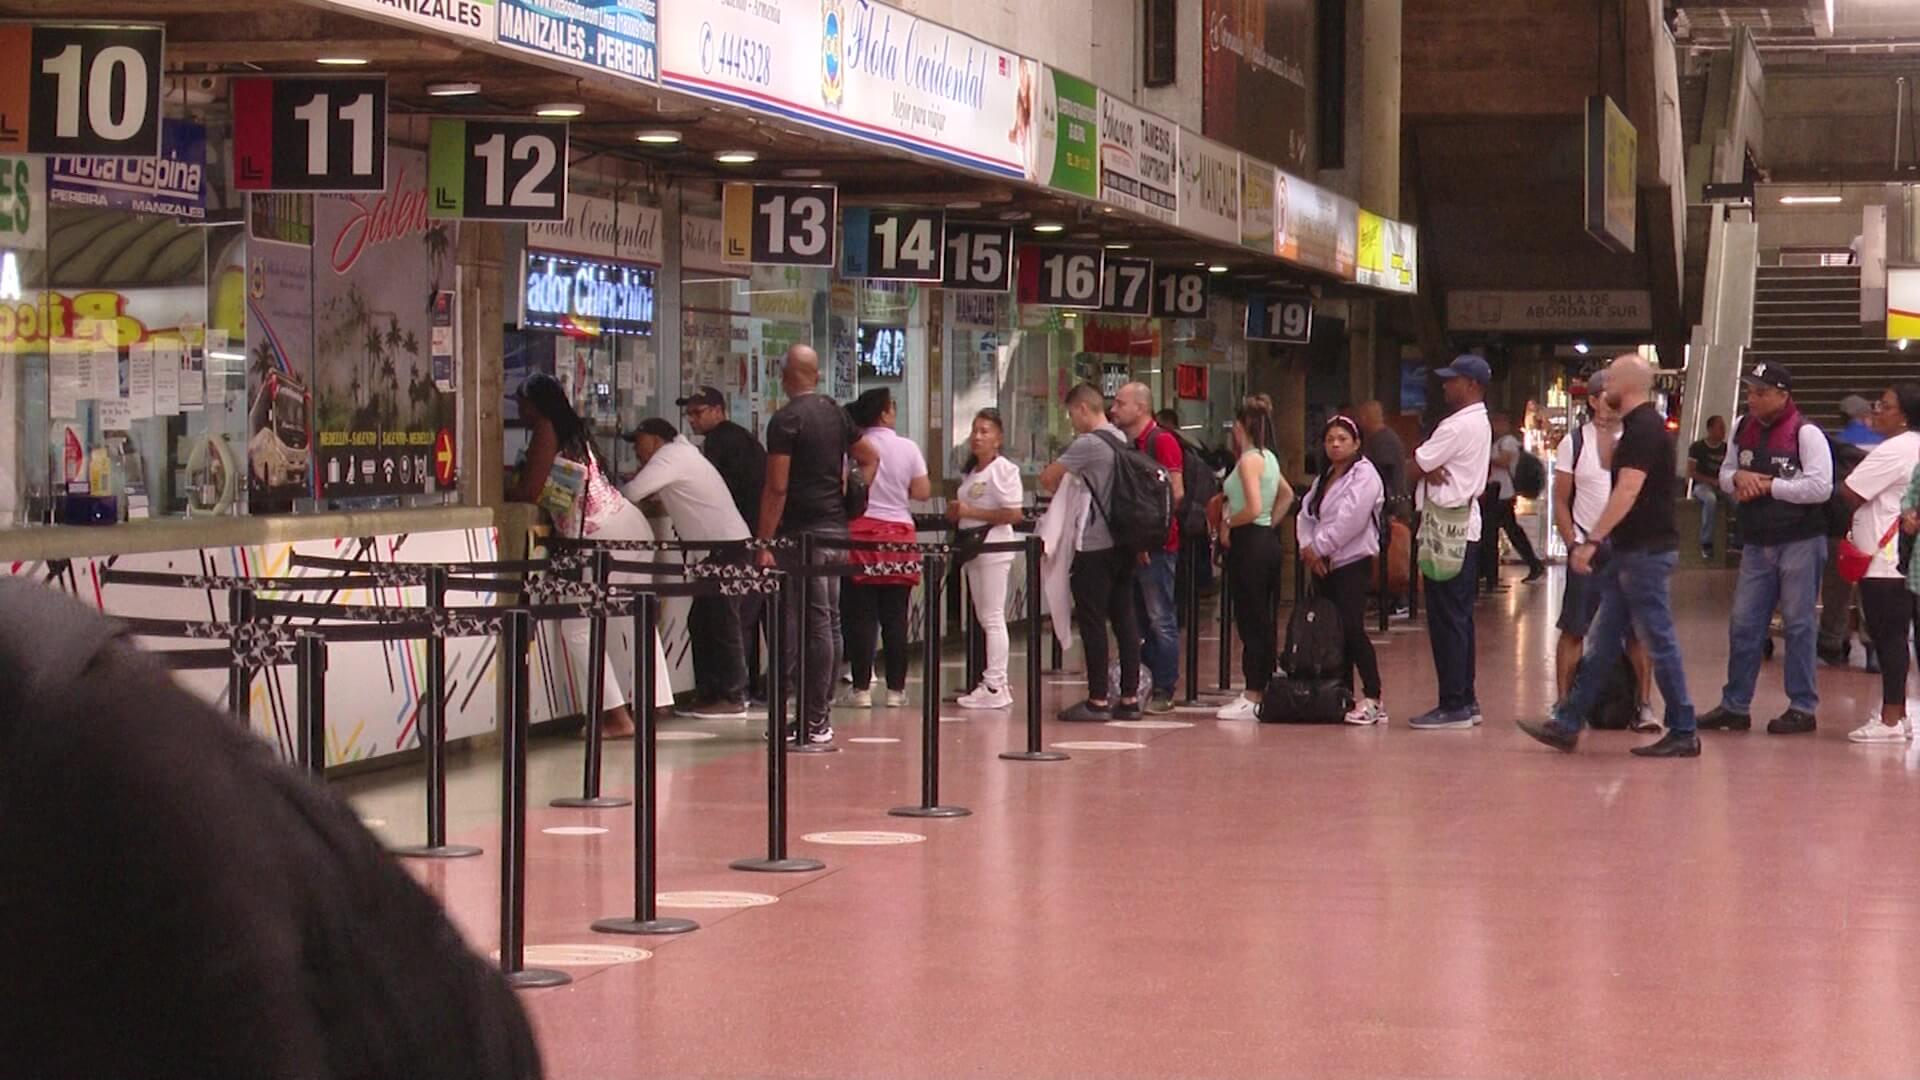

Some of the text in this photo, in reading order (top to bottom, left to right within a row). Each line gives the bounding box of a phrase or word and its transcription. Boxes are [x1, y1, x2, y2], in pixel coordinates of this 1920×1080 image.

[597, 32, 656, 80] PEREIRA
[718, 32, 772, 86] 4445328
[904, 17, 988, 110] Occidental
[42, 44, 149, 141] 10
[295, 93, 374, 176] 11
[122, 150, 200, 194] Ospina
[474, 133, 557, 208] 12
[51, 188, 108, 206] PEREIRA
[132, 199, 205, 218] MANIZALES
[580, 200, 657, 249] Occidental
[759, 195, 827, 256] 13
[874, 217, 936, 271] 14
[948, 232, 1002, 283] 15
[1044, 254, 1096, 300] 16
[1104, 266, 1146, 308] 17
[1159, 274, 1203, 313] 18
[1549, 293, 1610, 306] SALA DE
[1267, 302, 1306, 337] 19
[1525, 305, 1638, 318] ABORDAJE SUR
